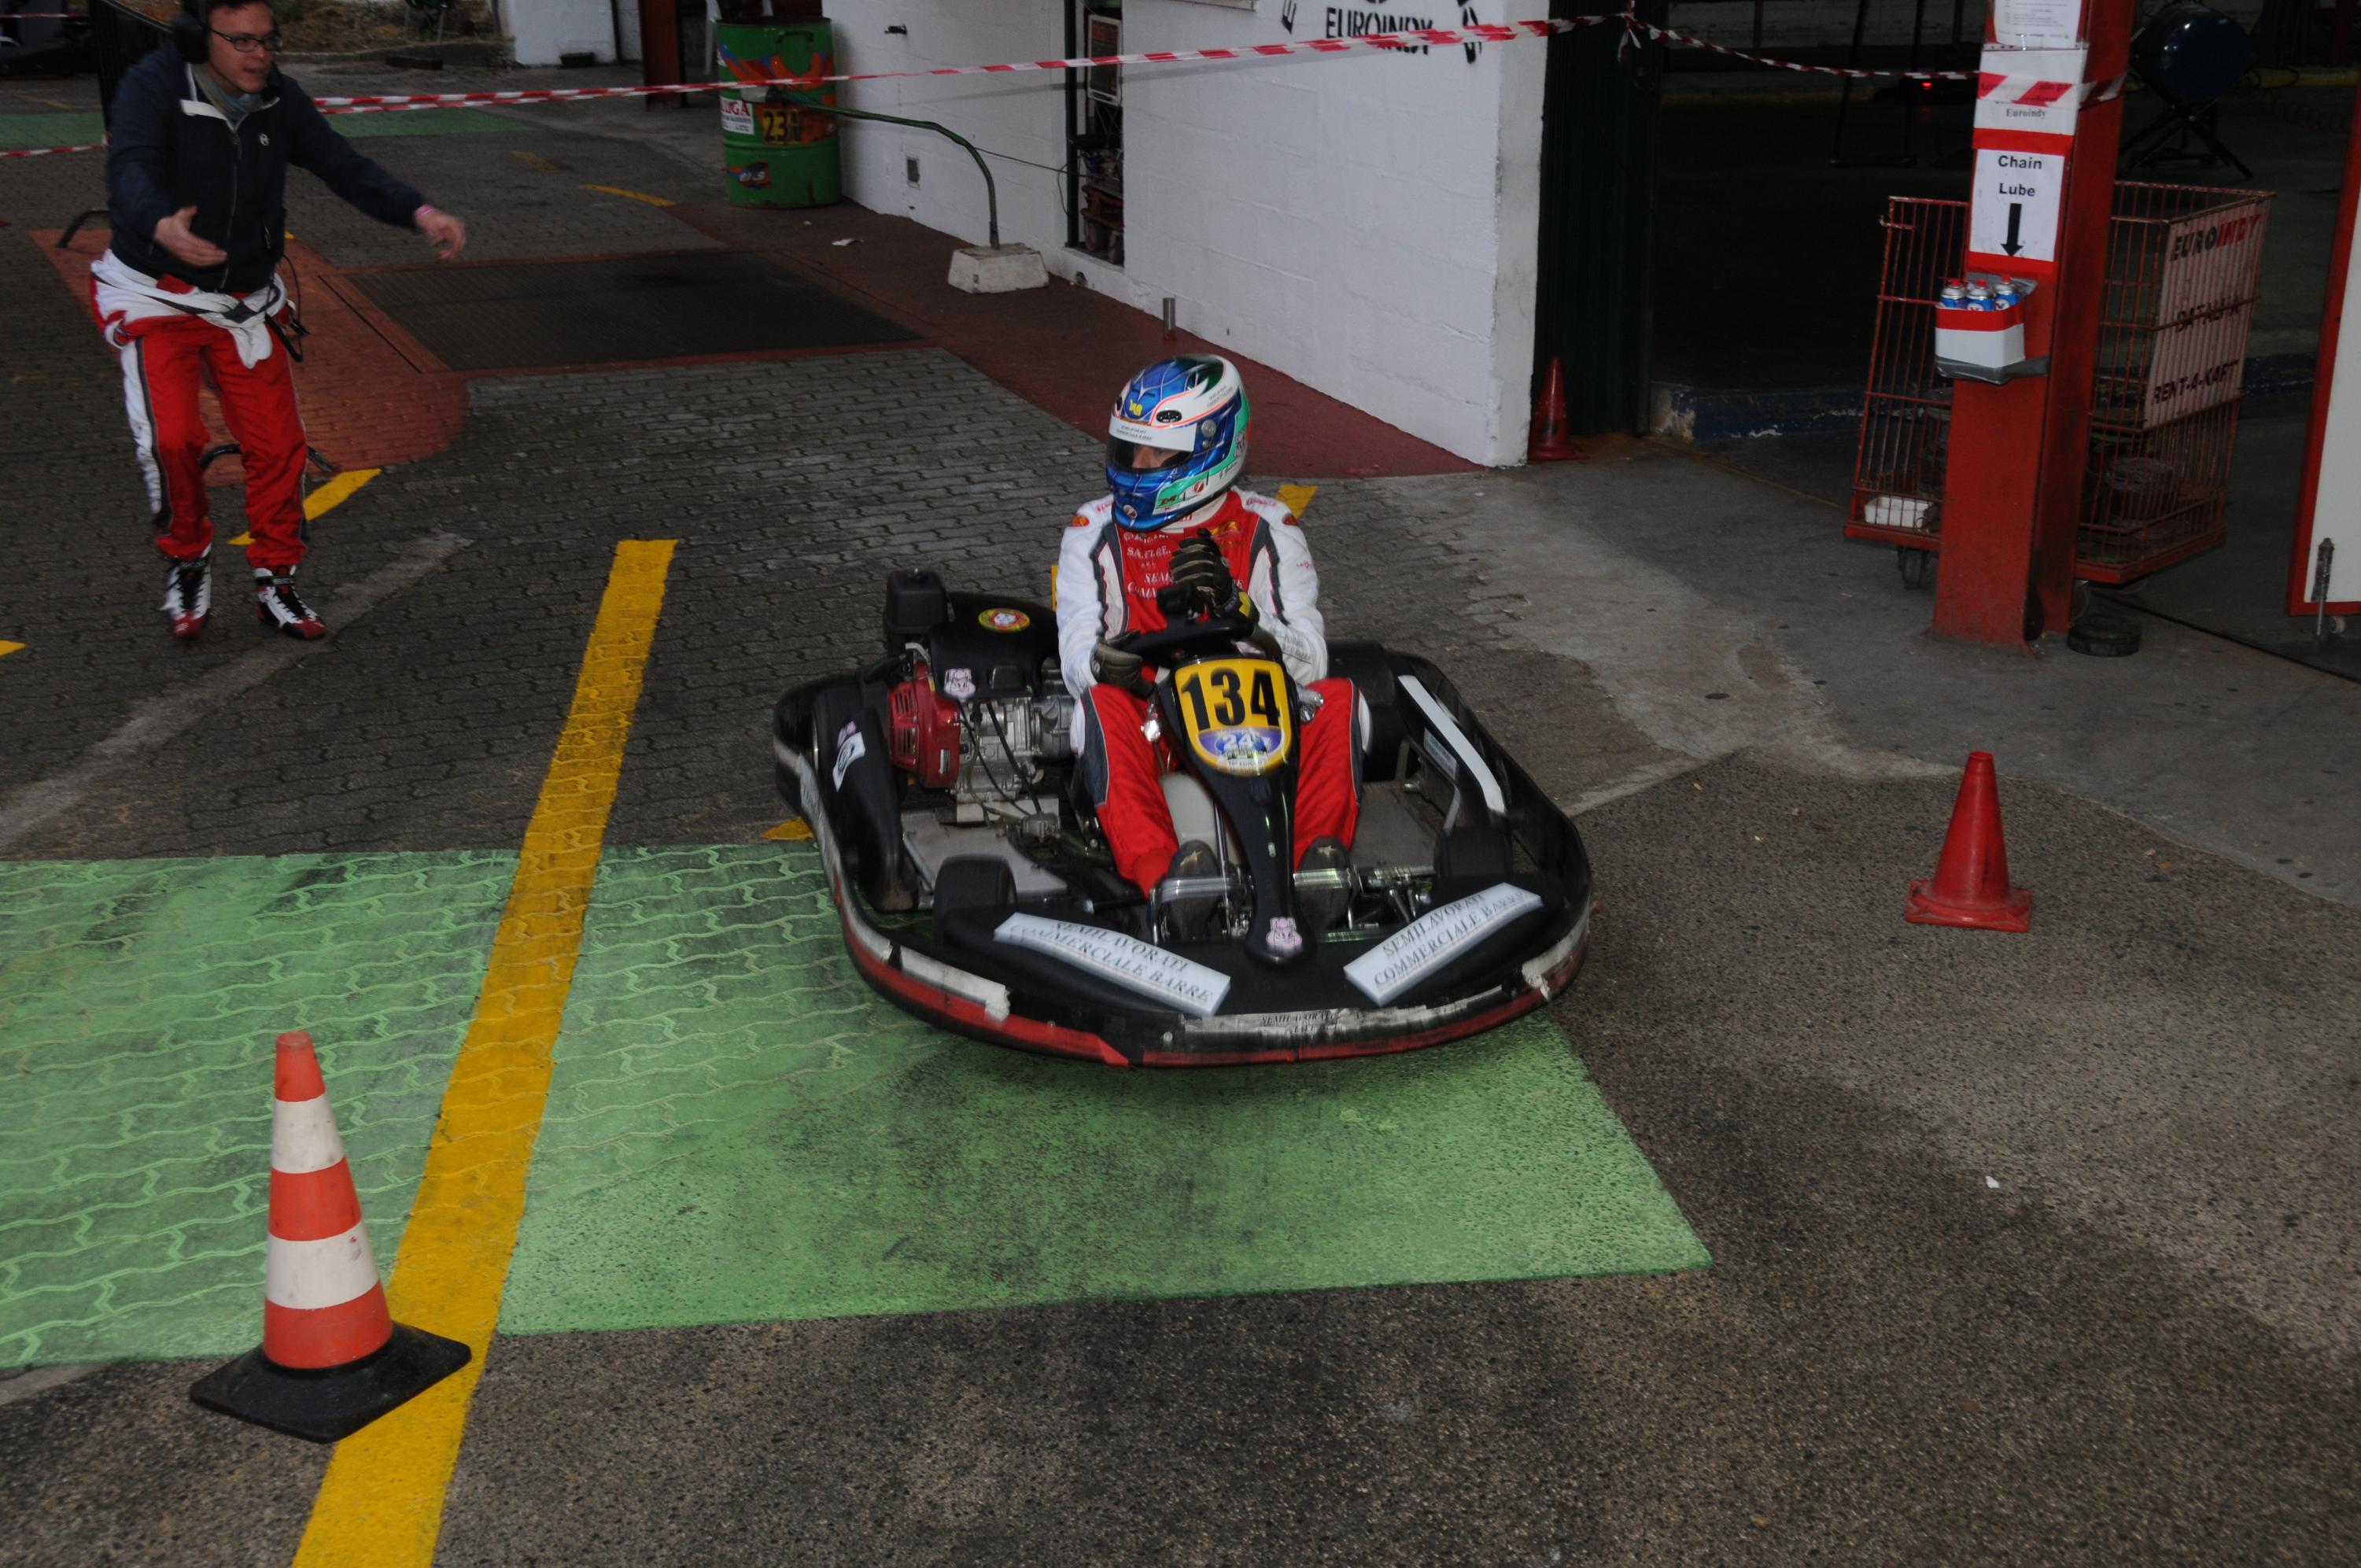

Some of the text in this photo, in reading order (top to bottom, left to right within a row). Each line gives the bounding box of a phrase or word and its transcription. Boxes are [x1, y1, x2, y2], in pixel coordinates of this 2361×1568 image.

[2006, 109, 2047, 120] Euroindy
[1998, 155, 2042, 170] Chain
[1999, 183, 2035, 197] Lube
[1181, 667, 1280, 732] 134
[1055, 921, 1192, 972] SEMILAVORATI
[1374, 913, 1482, 984] COMMERCIALE
[1382, 893, 1485, 957] SEMILAVORATI
[1009, 924, 1216, 1002] COMMERCIALE BARRE
